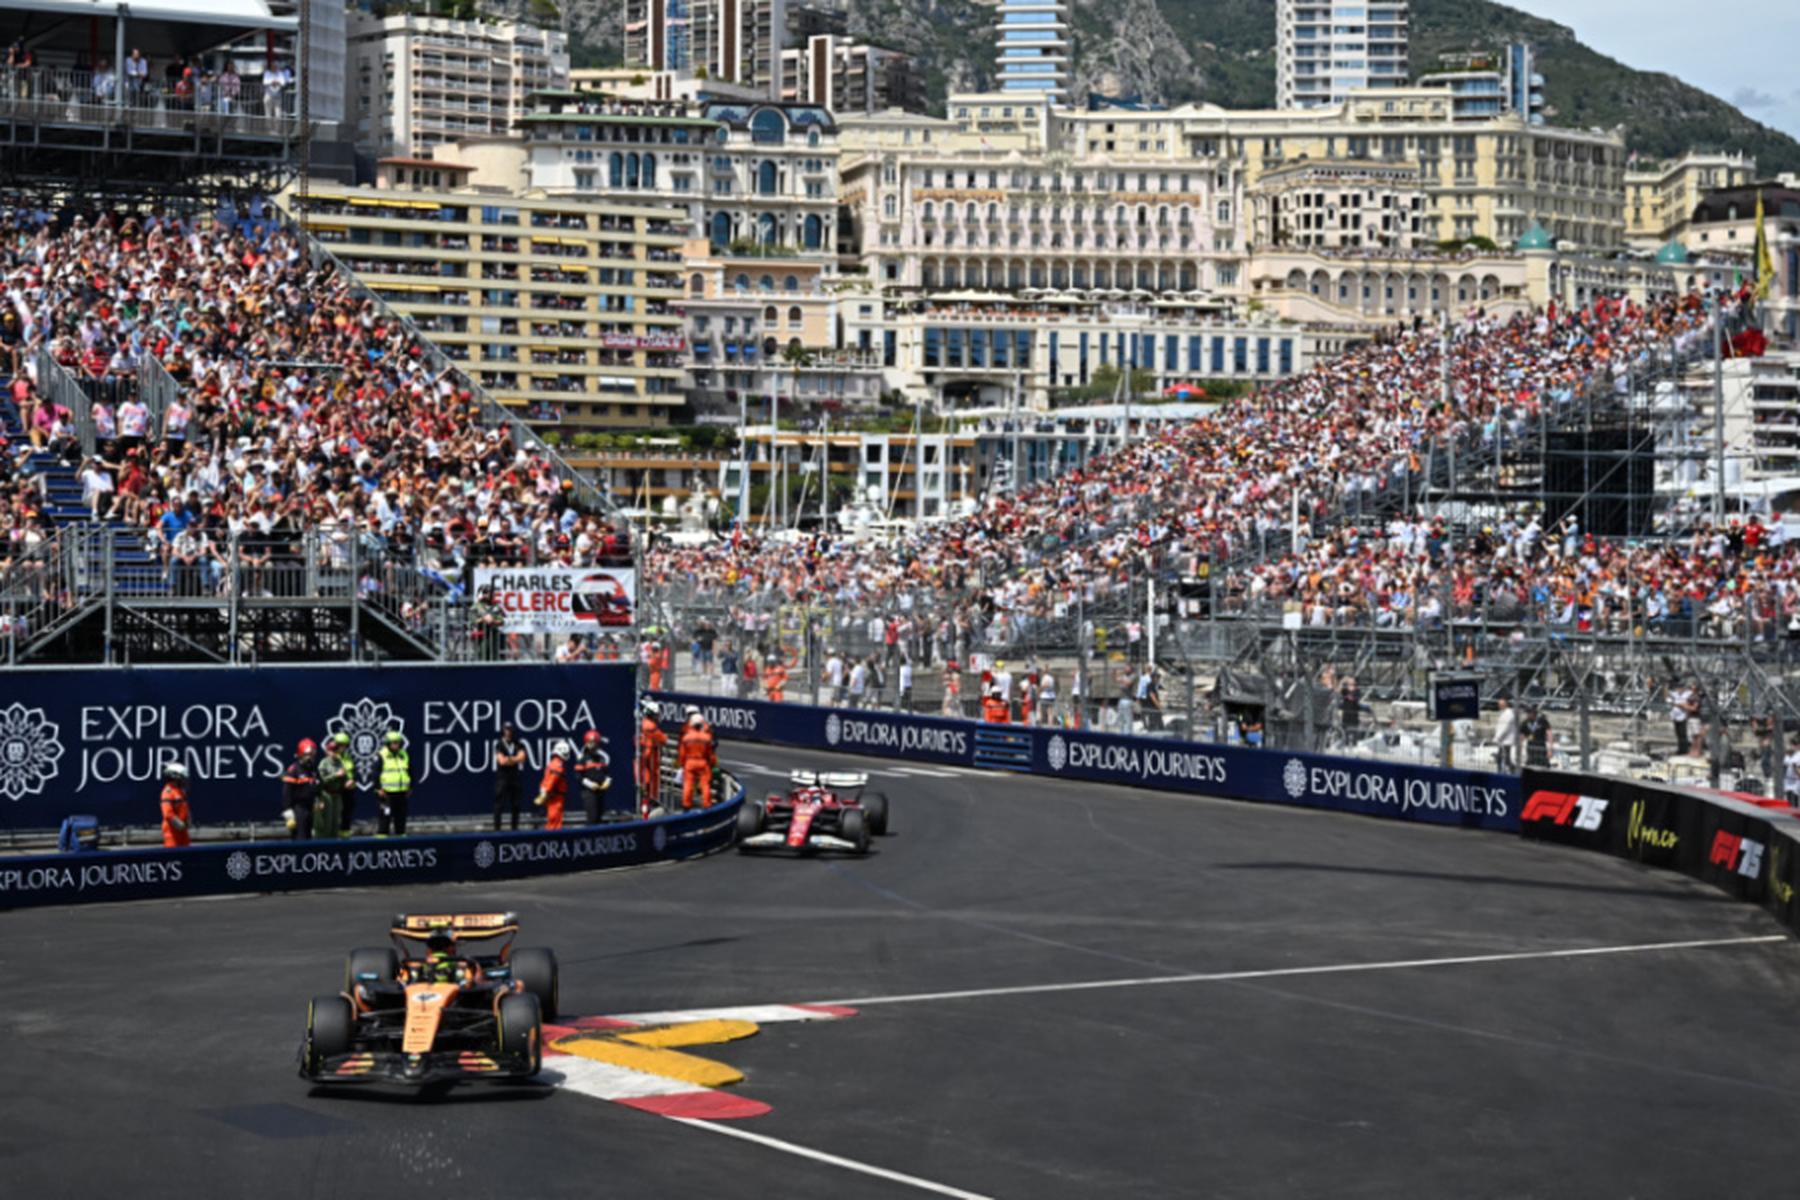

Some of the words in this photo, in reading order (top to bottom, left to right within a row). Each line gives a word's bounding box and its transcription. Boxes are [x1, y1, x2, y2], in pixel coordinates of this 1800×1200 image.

[491, 574, 573, 591] CHARLES
[492, 591, 570, 612] ECLERC
[81, 704, 269, 740] EXPLORA
[843, 720, 899, 747] EXPLORA
[901, 726, 967, 754] JOURNEYS
[75, 743, 284, 793] JOURNEYS
[1069, 742, 1140, 773] EXPLORA
[1142, 751, 1226, 783] JOURNEYS
[1311, 767, 1399, 804] EXPLORA
[1402, 778, 1507, 817] JOURNEYS
[255, 852, 344, 875] EXPLORA
[347, 848, 437, 876] JOURNEYS
[499, 840, 570, 863] EXPLORA
[572, 833, 637, 860] JOURNEYS
[0, 868, 75, 891] PLORA
[79, 860, 183, 892] JOURNEYS
